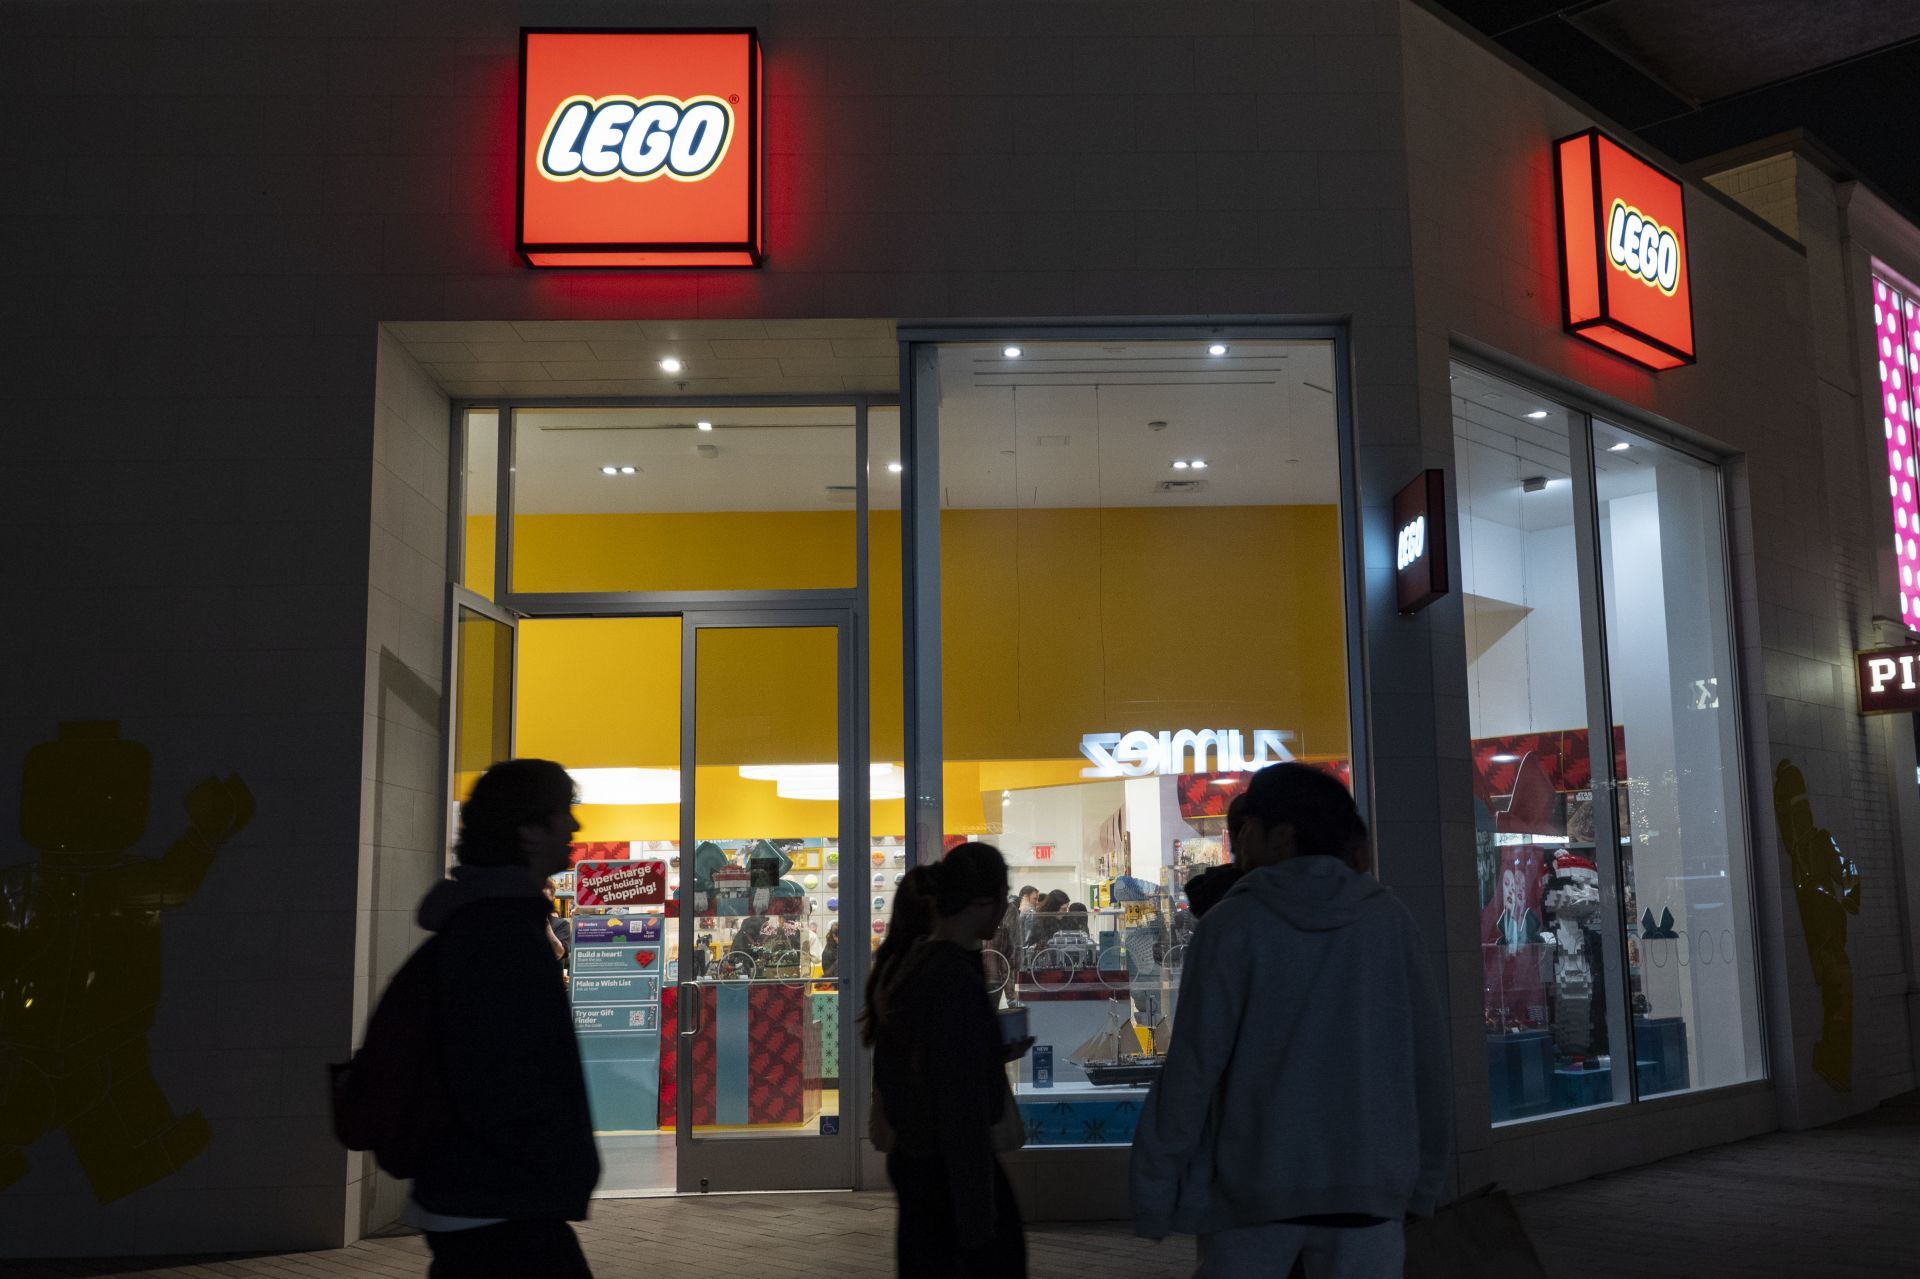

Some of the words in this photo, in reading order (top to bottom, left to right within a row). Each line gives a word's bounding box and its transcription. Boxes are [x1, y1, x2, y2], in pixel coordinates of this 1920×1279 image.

[539, 97, 733, 181] LEGO
[1608, 199, 1679, 295] LEGO
[1397, 515, 1425, 570] LEGO
[1868, 655, 1920, 693] PI
[1035, 847, 1051, 859] EXIT
[582, 865, 651, 887] Supercharge
[593, 885, 612, 896] your
[613, 878, 644, 890] holiday
[603, 882, 657, 903] shopping!
[618, 979, 632, 987] List
[576, 1010, 587, 1018] Try
[600, 1009, 614, 1017] Gift
